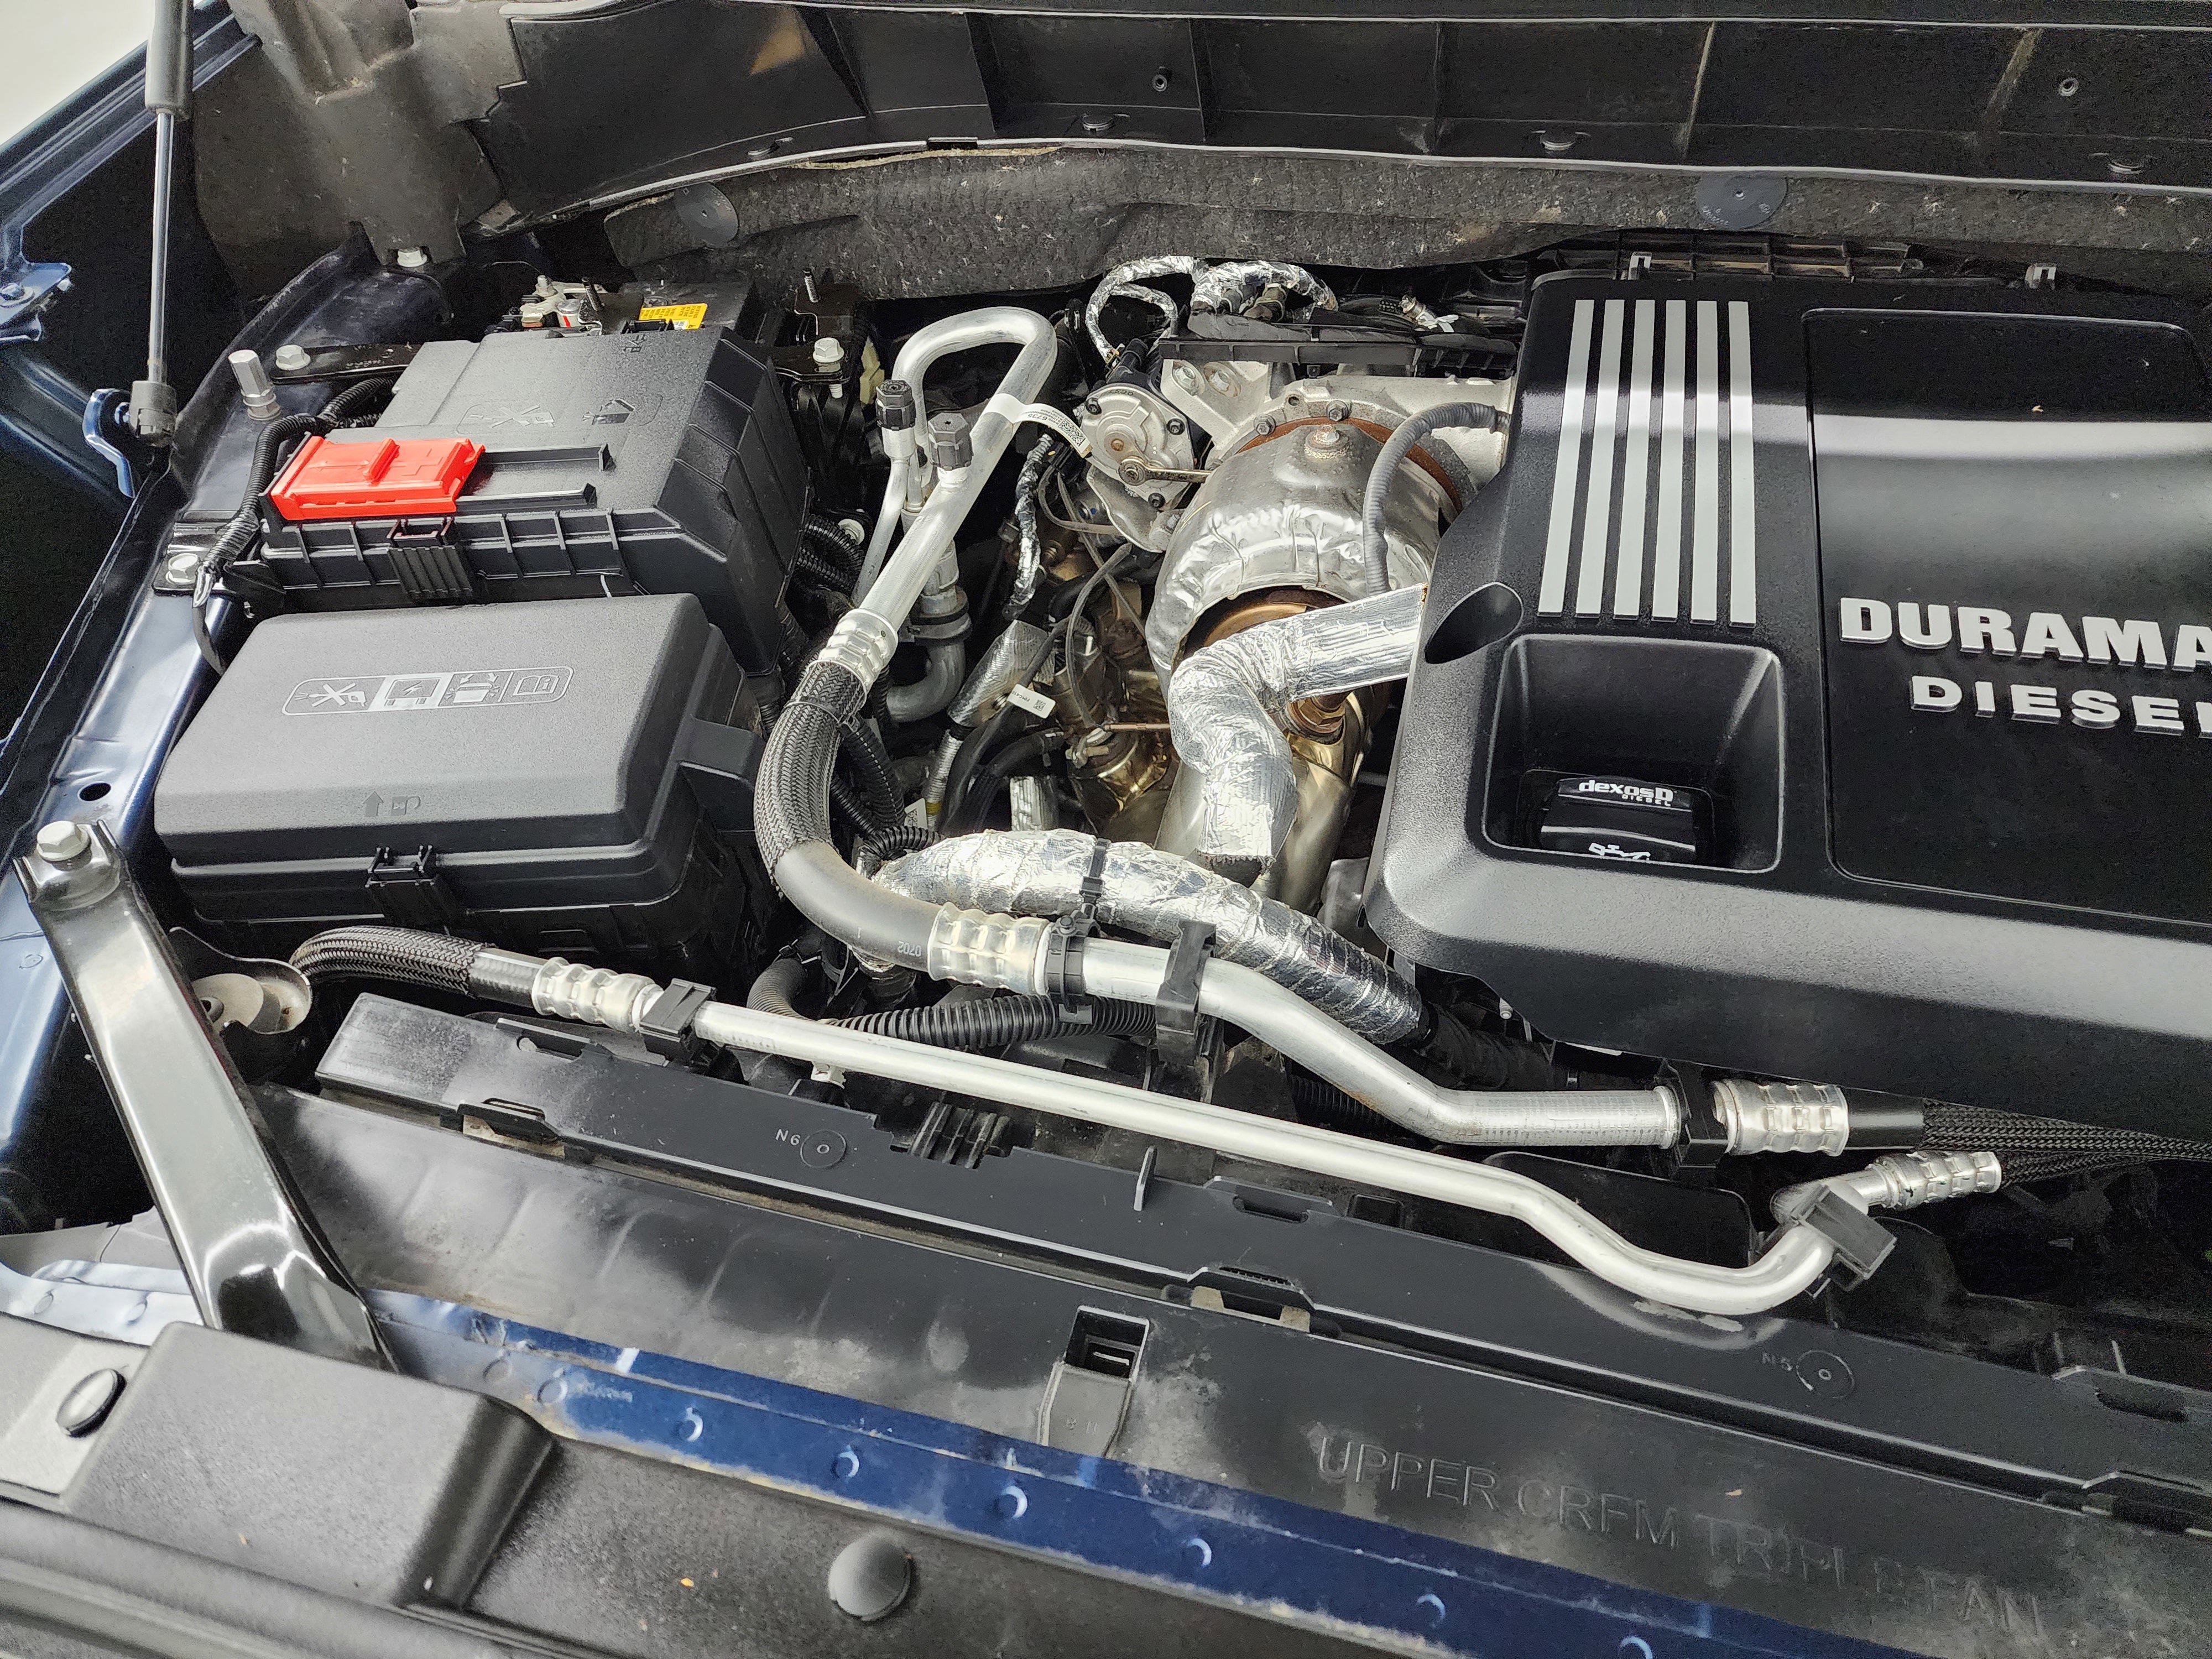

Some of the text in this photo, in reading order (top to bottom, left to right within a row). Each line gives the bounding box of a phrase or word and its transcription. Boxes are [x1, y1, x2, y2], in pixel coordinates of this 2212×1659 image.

[1621, 794, 1671, 807] DIESEL
[897, 941, 922, 957] 0702
[775, 1129, 801, 1146] N6
[1319, 1437, 1500, 1510] UPPER
[1517, 1479, 1680, 1547] CRFM
